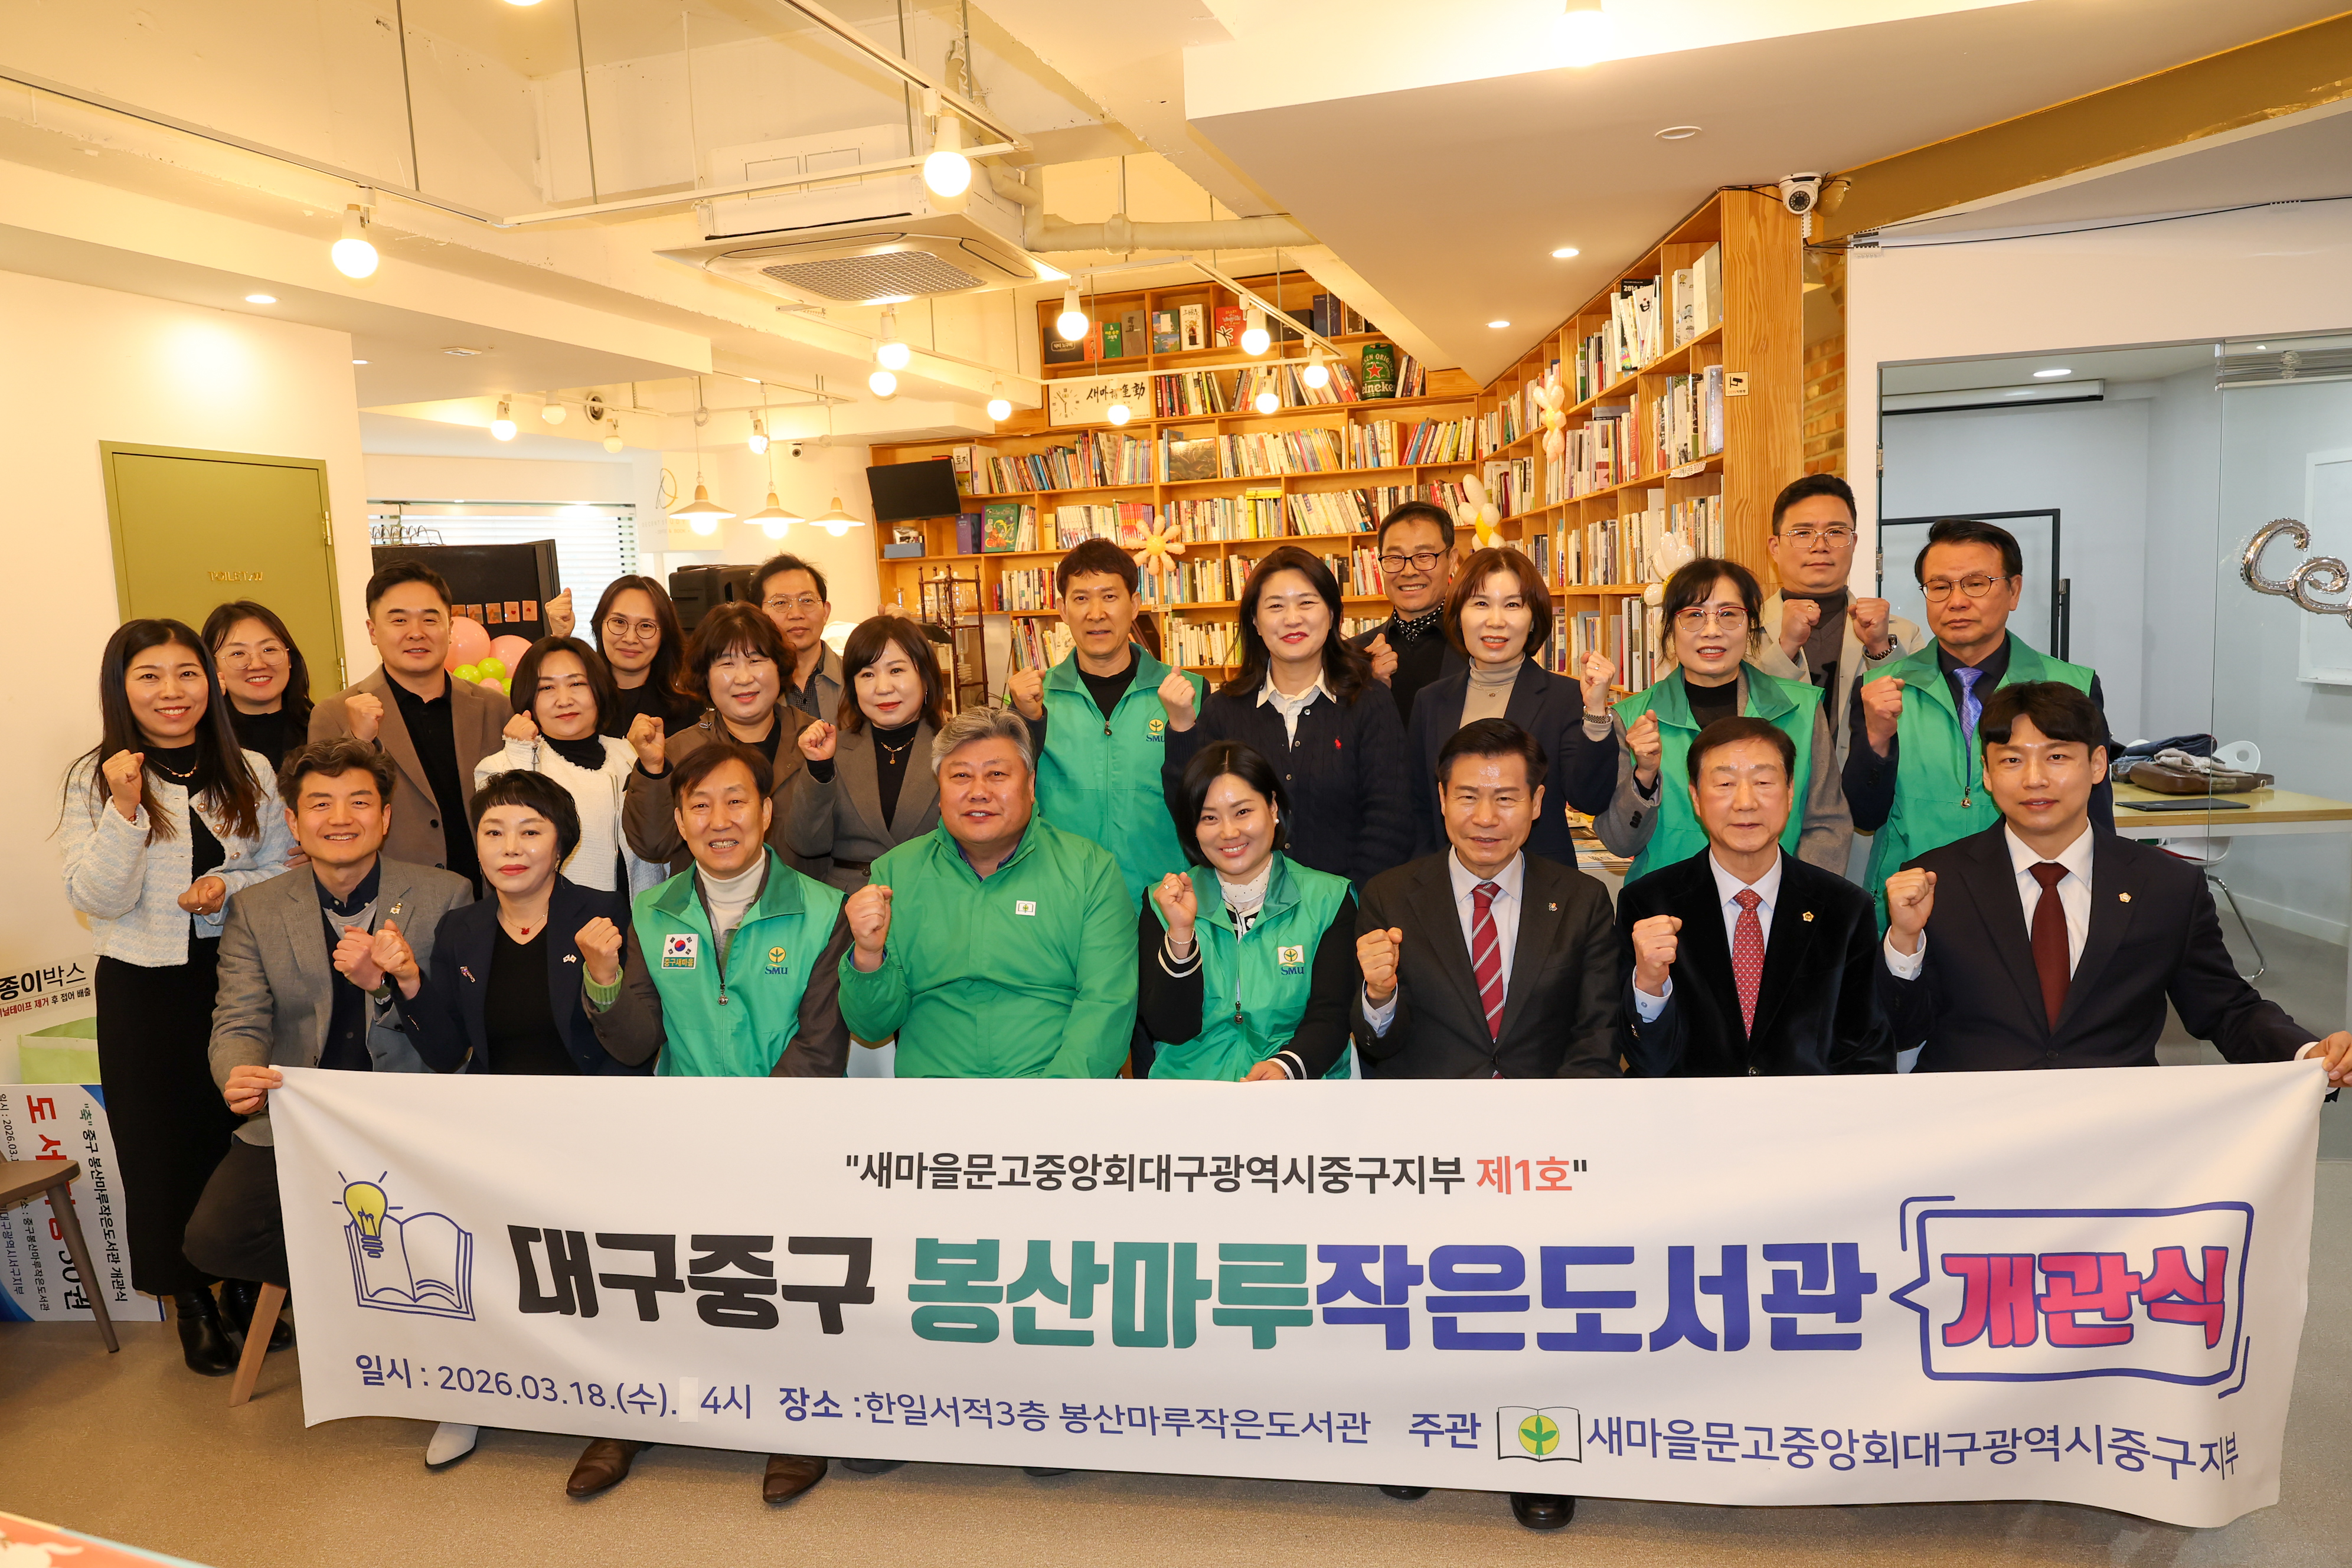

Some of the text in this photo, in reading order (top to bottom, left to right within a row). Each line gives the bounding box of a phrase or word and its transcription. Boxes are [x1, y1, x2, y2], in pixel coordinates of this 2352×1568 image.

[0, 963, 86, 1001] 종이박스
[664, 959, 694, 967] 중구새마을
[1281, 966, 1304, 975] SMU
[34, 998, 49, 1008] 제거
[51, 995, 58, 1004] 후
[61, 991, 74, 1002] 접어
[77, 987, 91, 998] 배출
[83, 1129, 99, 1153] 중구
[847, 1152, 1587, 1195] "새마을문고중앙회대구광역시중구지부 제1호"
[89, 1157, 120, 1263] 봉산마루작은도서관
[0, 1205, 24, 1295] 대구광역시서구지부
[23, 1217, 50, 1311] 중구봉산마루작은도서관
[110, 1267, 128, 1301] 개관식
[507, 1224, 876, 1335] 대구중구
[1941, 1246, 2229, 1350] 개관식
[356, 1355, 412, 1389] 일시
[701, 1384, 750, 1419] 4시
[779, 1387, 843, 1421] 장소
[1059, 1403, 1371, 1443] 봉산마루작은도서관
[1409, 1413, 1482, 1449] 주관
[1587, 1417, 2239, 1480] 새마을문고중앙회대구광역시중구지부
